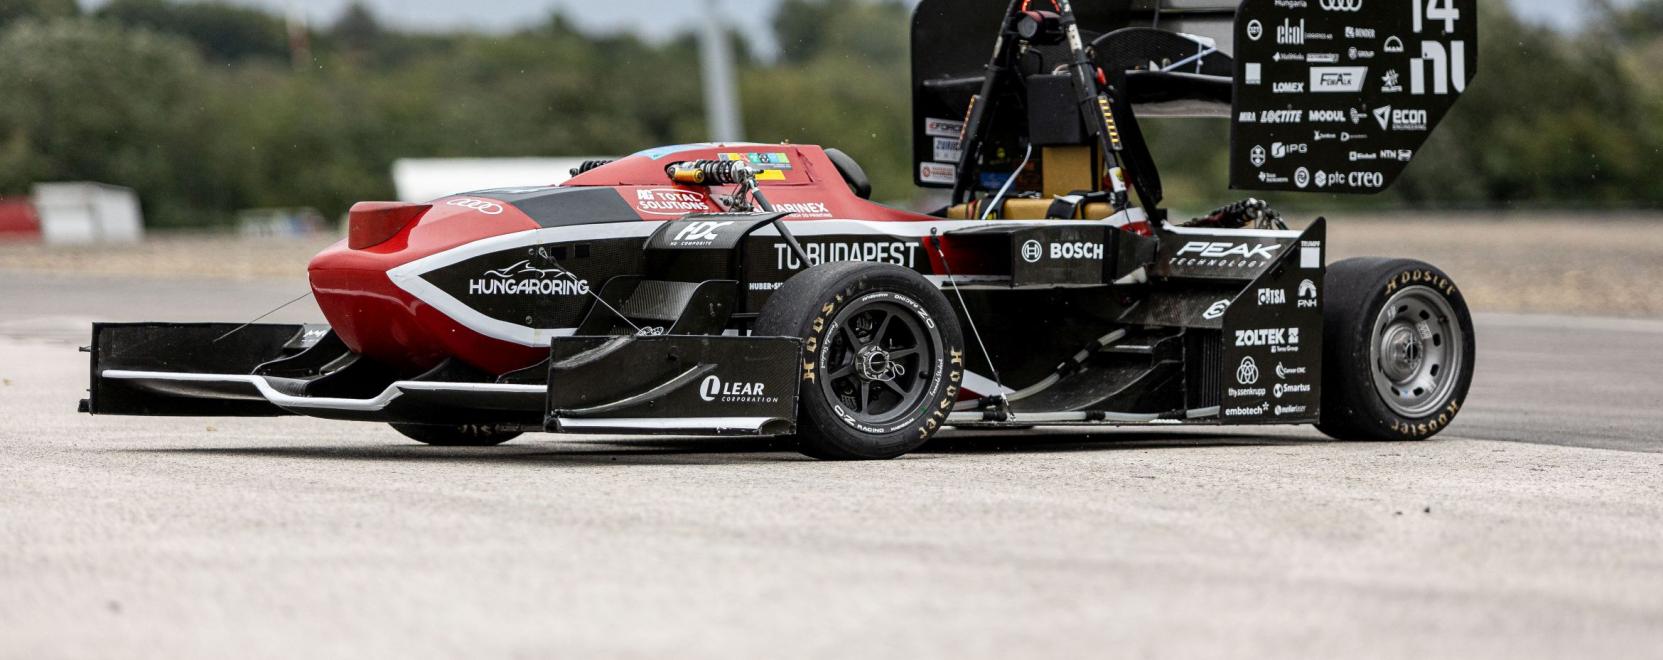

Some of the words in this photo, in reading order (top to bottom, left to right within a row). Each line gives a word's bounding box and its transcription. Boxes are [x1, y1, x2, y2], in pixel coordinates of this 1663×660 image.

[1412, 0, 1460, 33] 14
[1272, 82, 1304, 93] LOMEX
[1260, 110, 1302, 123] LOCTITE
[1308, 110, 1346, 122] MODUL
[1392, 109, 1427, 124] econ
[1286, 143, 1308, 154] IPG
[1380, 149, 1397, 159] NTN
[1328, 171, 1346, 187] ptc
[1348, 171, 1384, 188] creo
[656, 191, 702, 202] TOTAL
[640, 200, 709, 210] SOLUTIONS
[807, 242, 920, 268] BUDAPEST
[1049, 242, 1104, 260] BOSCH
[1176, 241, 1282, 260] PEAK
[1168, 257, 1267, 268] TECHNOLOGY
[469, 279, 590, 295] HUNGARORING
[1235, 327, 1286, 347] ZOLTEK
[723, 382, 765, 396] LEAR
[1228, 387, 1267, 398] thyssenkrupp
[1283, 383, 1311, 393] Smartus
